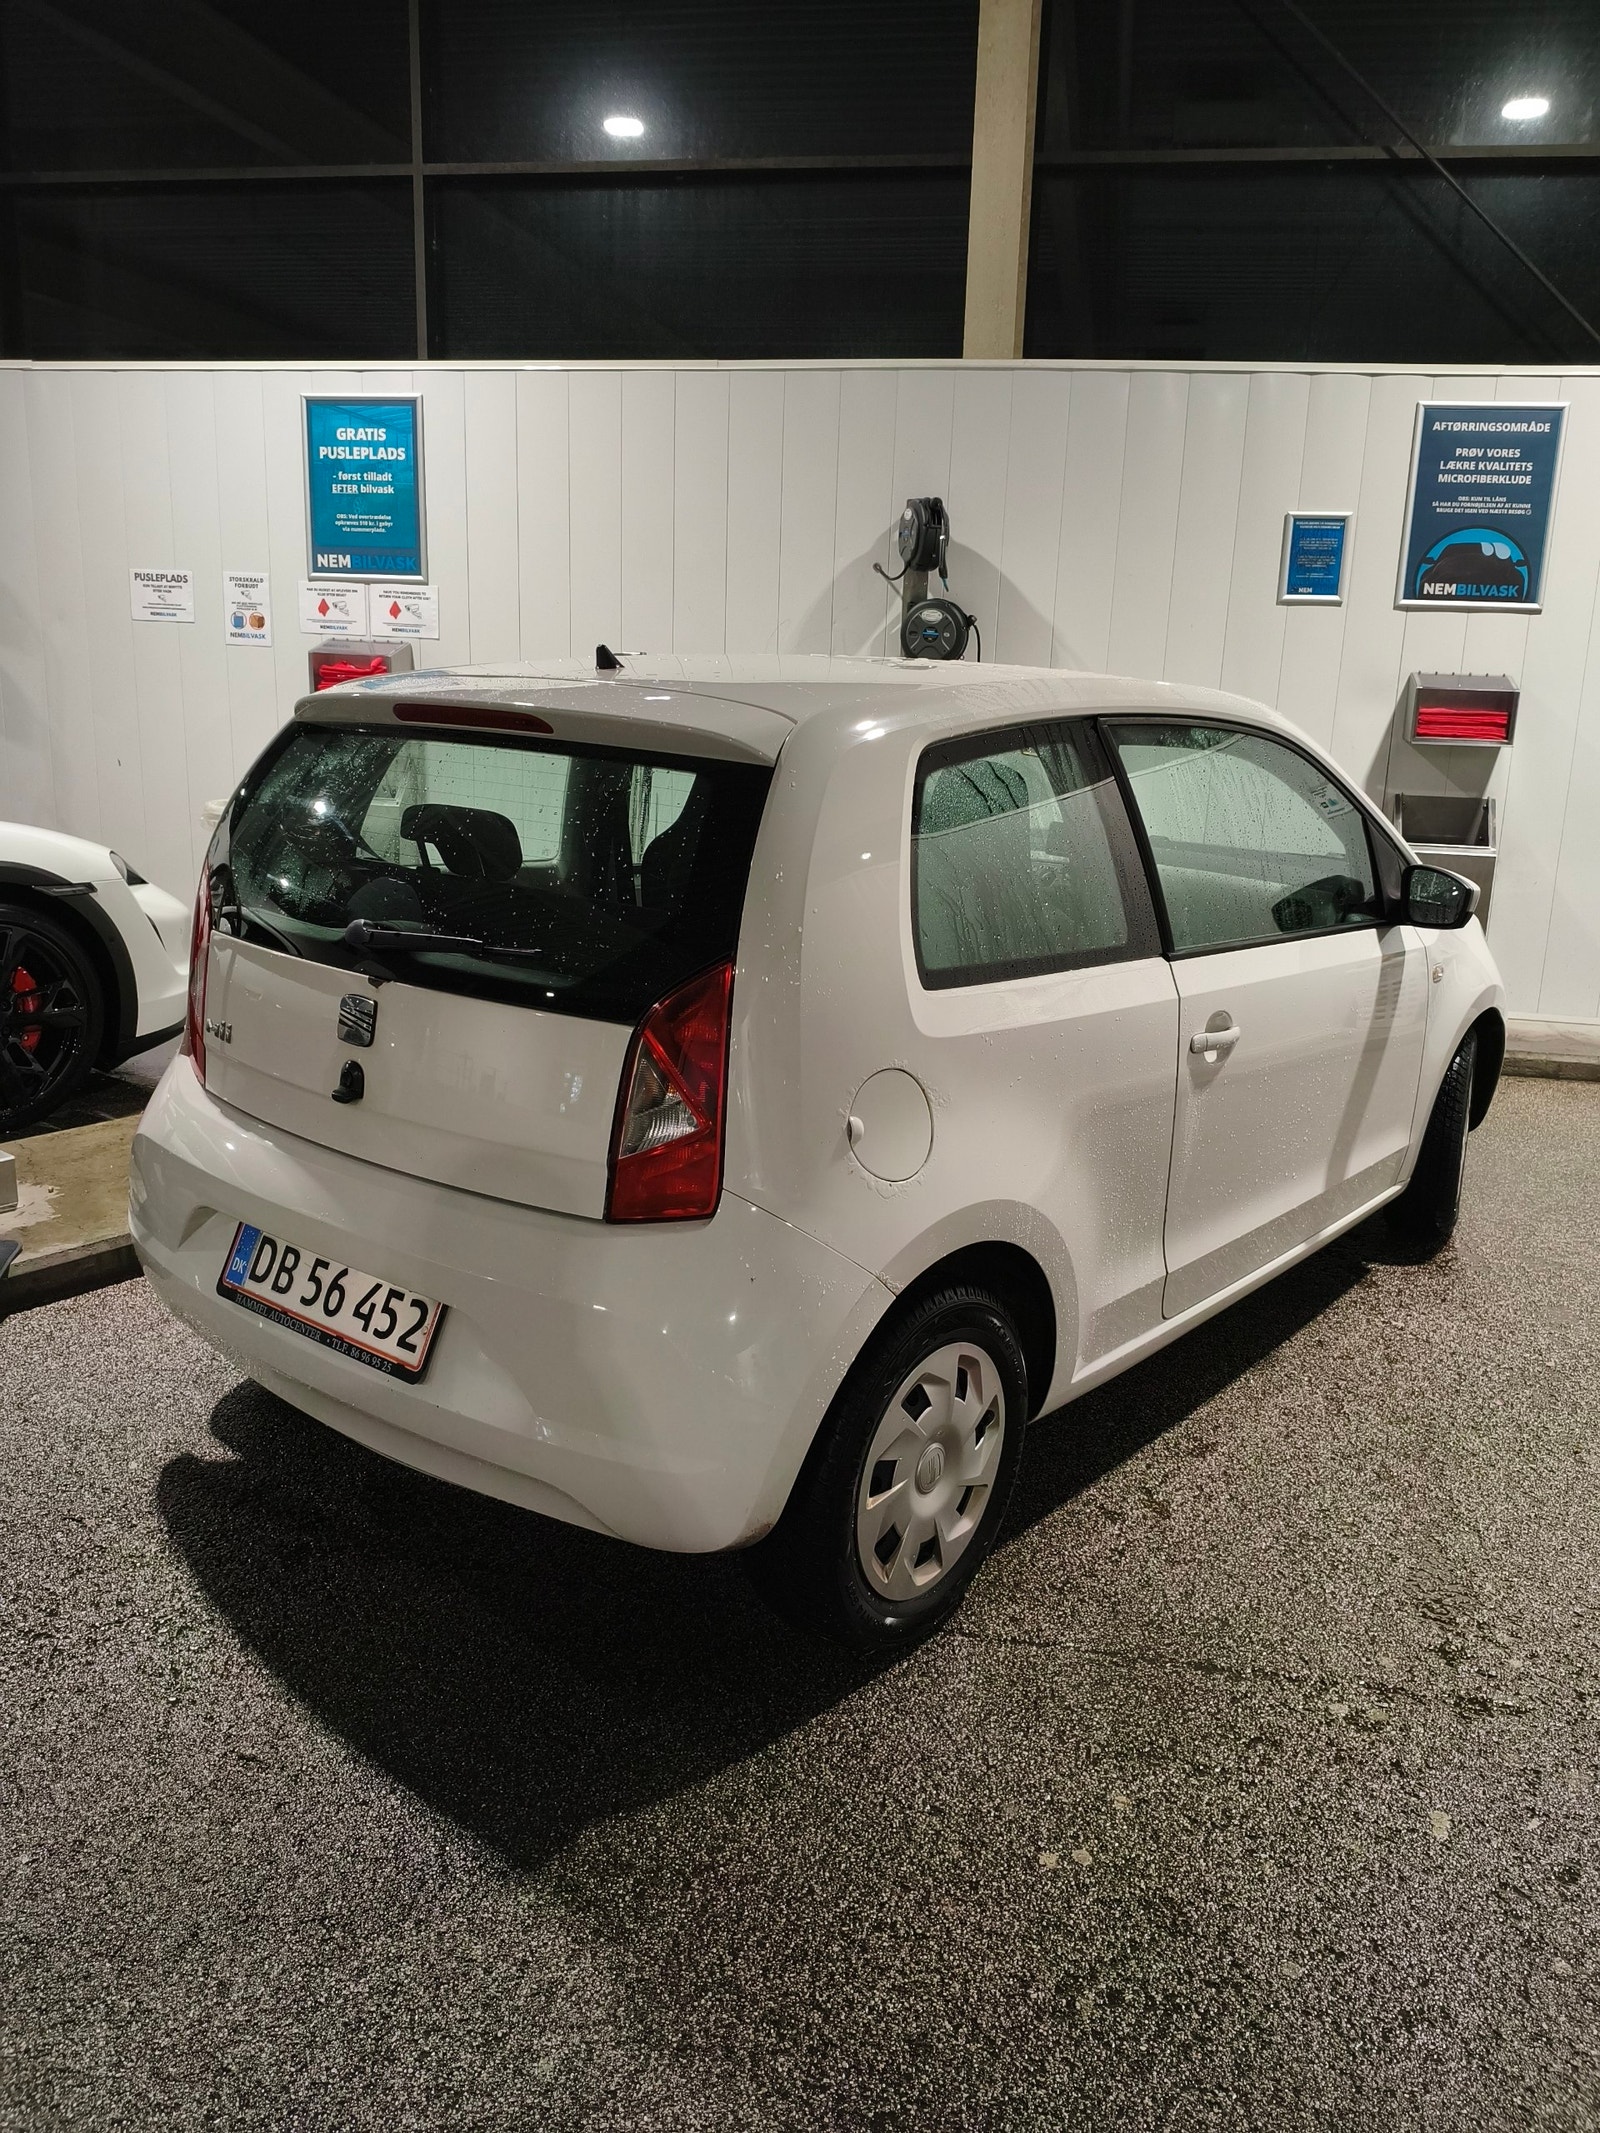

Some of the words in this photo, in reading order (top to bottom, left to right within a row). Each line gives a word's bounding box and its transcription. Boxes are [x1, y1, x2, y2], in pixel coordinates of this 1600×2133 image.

[1432, 421, 1551, 432] AFTØRRINGSOMRÅDE
[336, 427, 387, 441] GRATIS
[319, 446, 406, 460] PUSLEPLADS
[1455, 448, 1484, 457] PRØV
[1486, 448, 1521, 458] VORES
[1440, 460, 1476, 470] LÆKRE
[1478, 461, 1533, 471] KVALITETS
[338, 471, 361, 481] først
[363, 471, 393, 482] tilladt
[1437, 473, 1532, 484] MICROFIBERKLUDE
[331, 484, 359, 494] EFTER
[360, 484, 394, 494] bilvask
[317, 553, 417, 570] NEMBILVASK
[134, 572, 188, 584] PUSLEPLADS
[1423, 582, 1519, 597] NEMBILVASK
[230, 631, 266, 639] NEMBILVASK
[231, 1256, 246, 1275] DK
[248, 1235, 301, 1295] DB
[299, 1257, 349, 1318] 56
[352, 1282, 429, 1354] 452
[235, 1293, 268, 1317] HAMMEL
[268, 1310, 321, 1341] AUTOCENTER
[332, 1337, 348, 1354] TLF.
[350, 1346, 361, 1359] 86
[361, 1351, 371, 1363] 96
[371, 1356, 381, 1368] 95
[381, 1361, 392, 1373] 25
